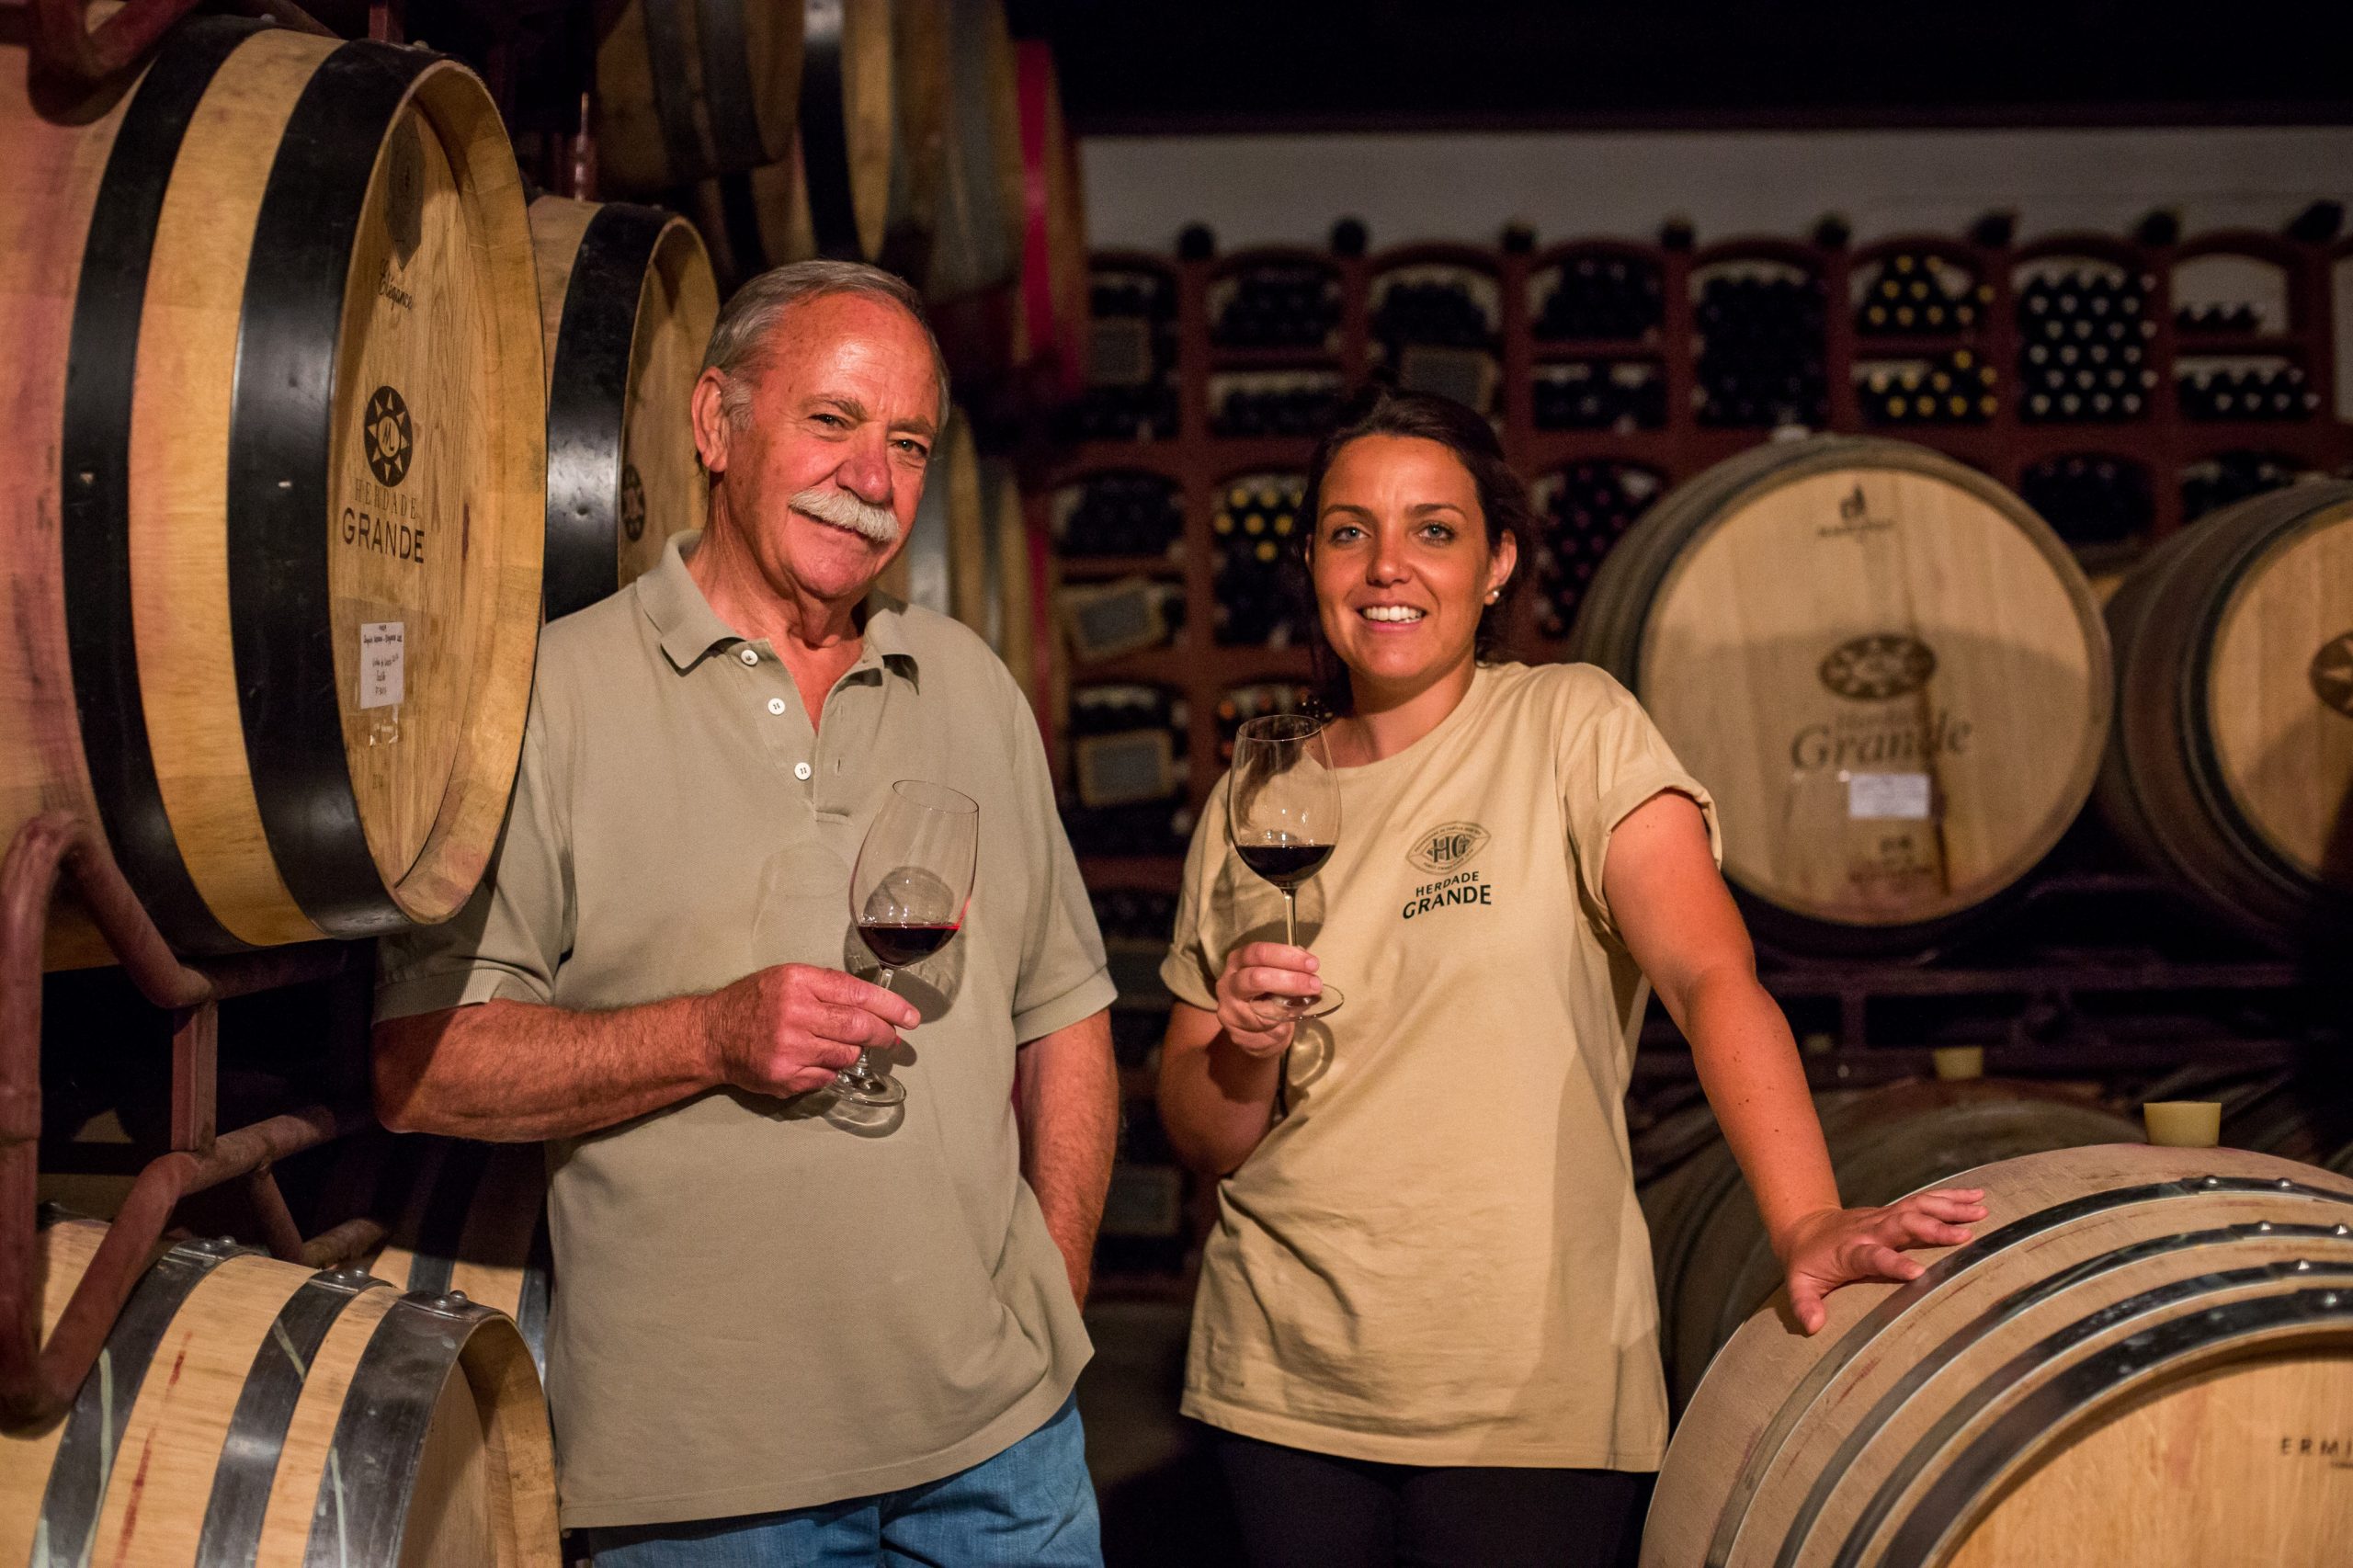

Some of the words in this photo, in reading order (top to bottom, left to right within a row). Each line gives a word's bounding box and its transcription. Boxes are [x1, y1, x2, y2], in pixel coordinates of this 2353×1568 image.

[355, 477, 416, 519] HERDADE
[342, 506, 425, 563] GRANDE
[1402, 884, 1492, 920] GRANDE
[1415, 870, 1480, 897] HERDADE
